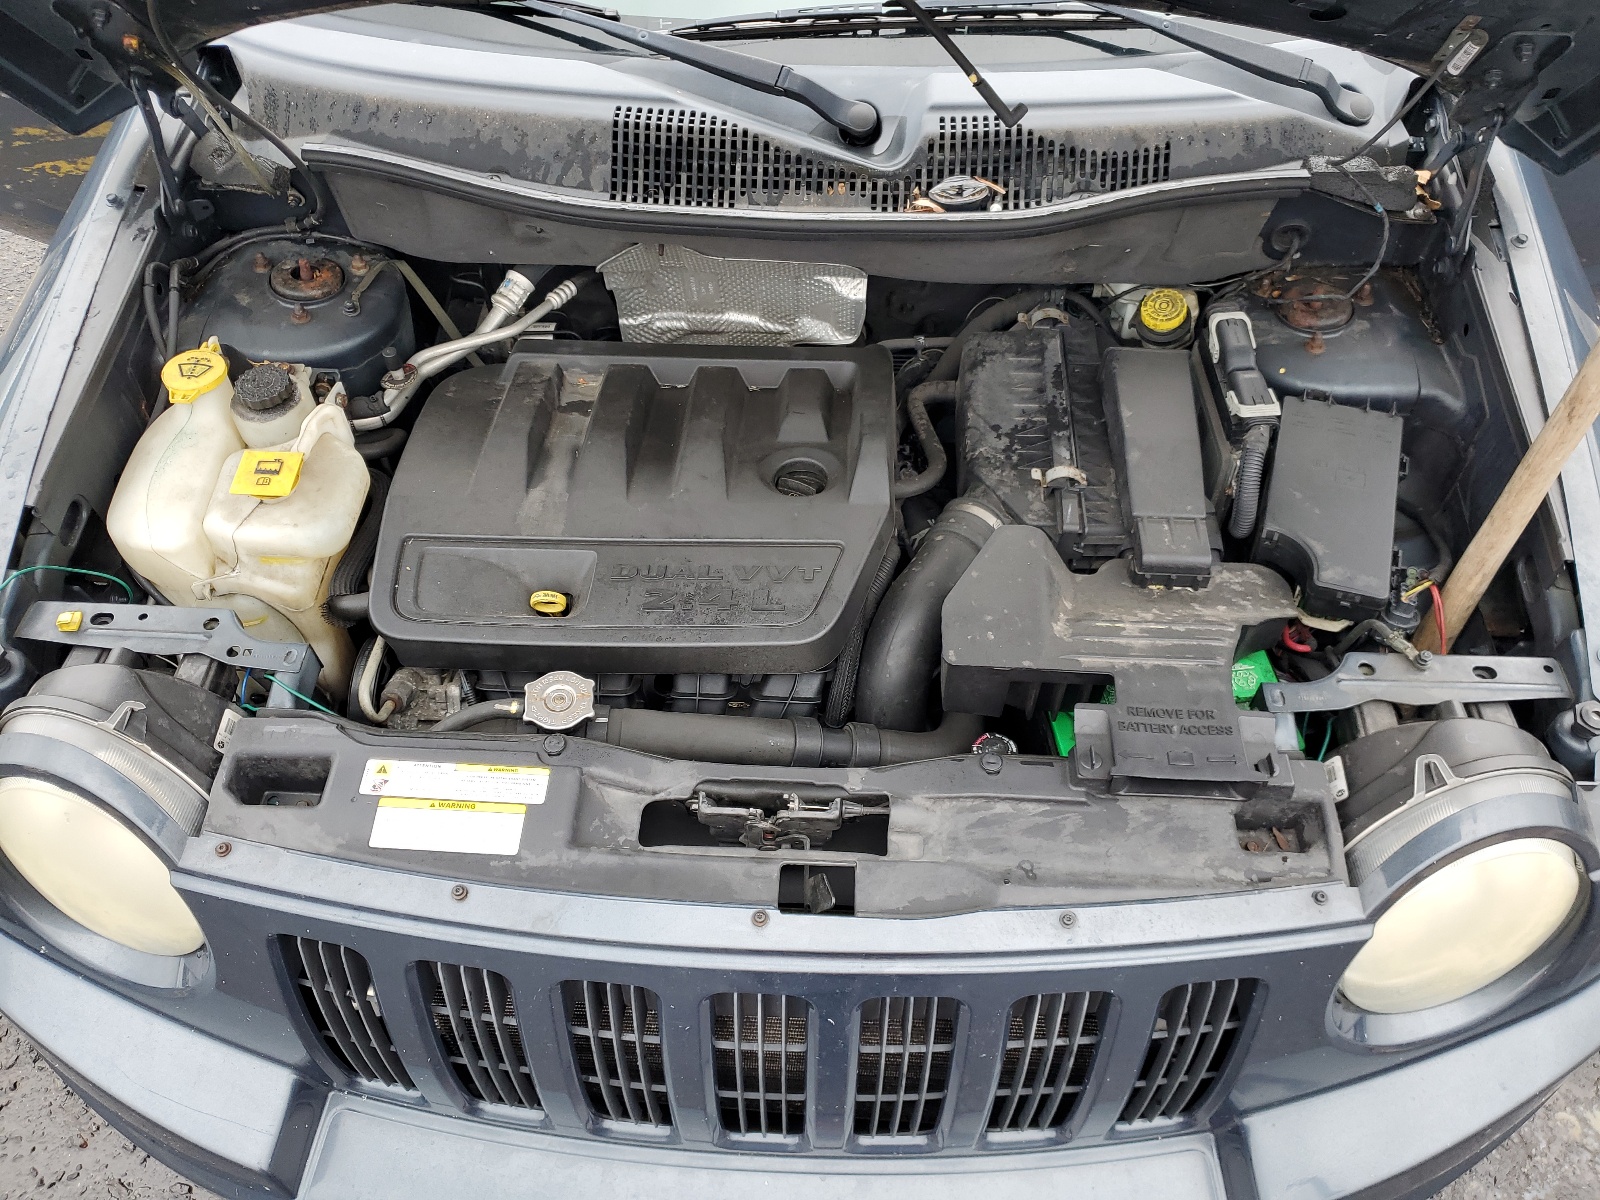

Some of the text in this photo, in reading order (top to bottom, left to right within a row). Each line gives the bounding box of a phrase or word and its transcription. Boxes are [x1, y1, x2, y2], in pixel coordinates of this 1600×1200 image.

[610, 563, 823, 583] DUAL VVT
[1126, 706, 1216, 720] REMOVE FOR
[1118, 721, 1234, 736] BATTERY ACCESS
[438, 802, 476, 810] WARNING
